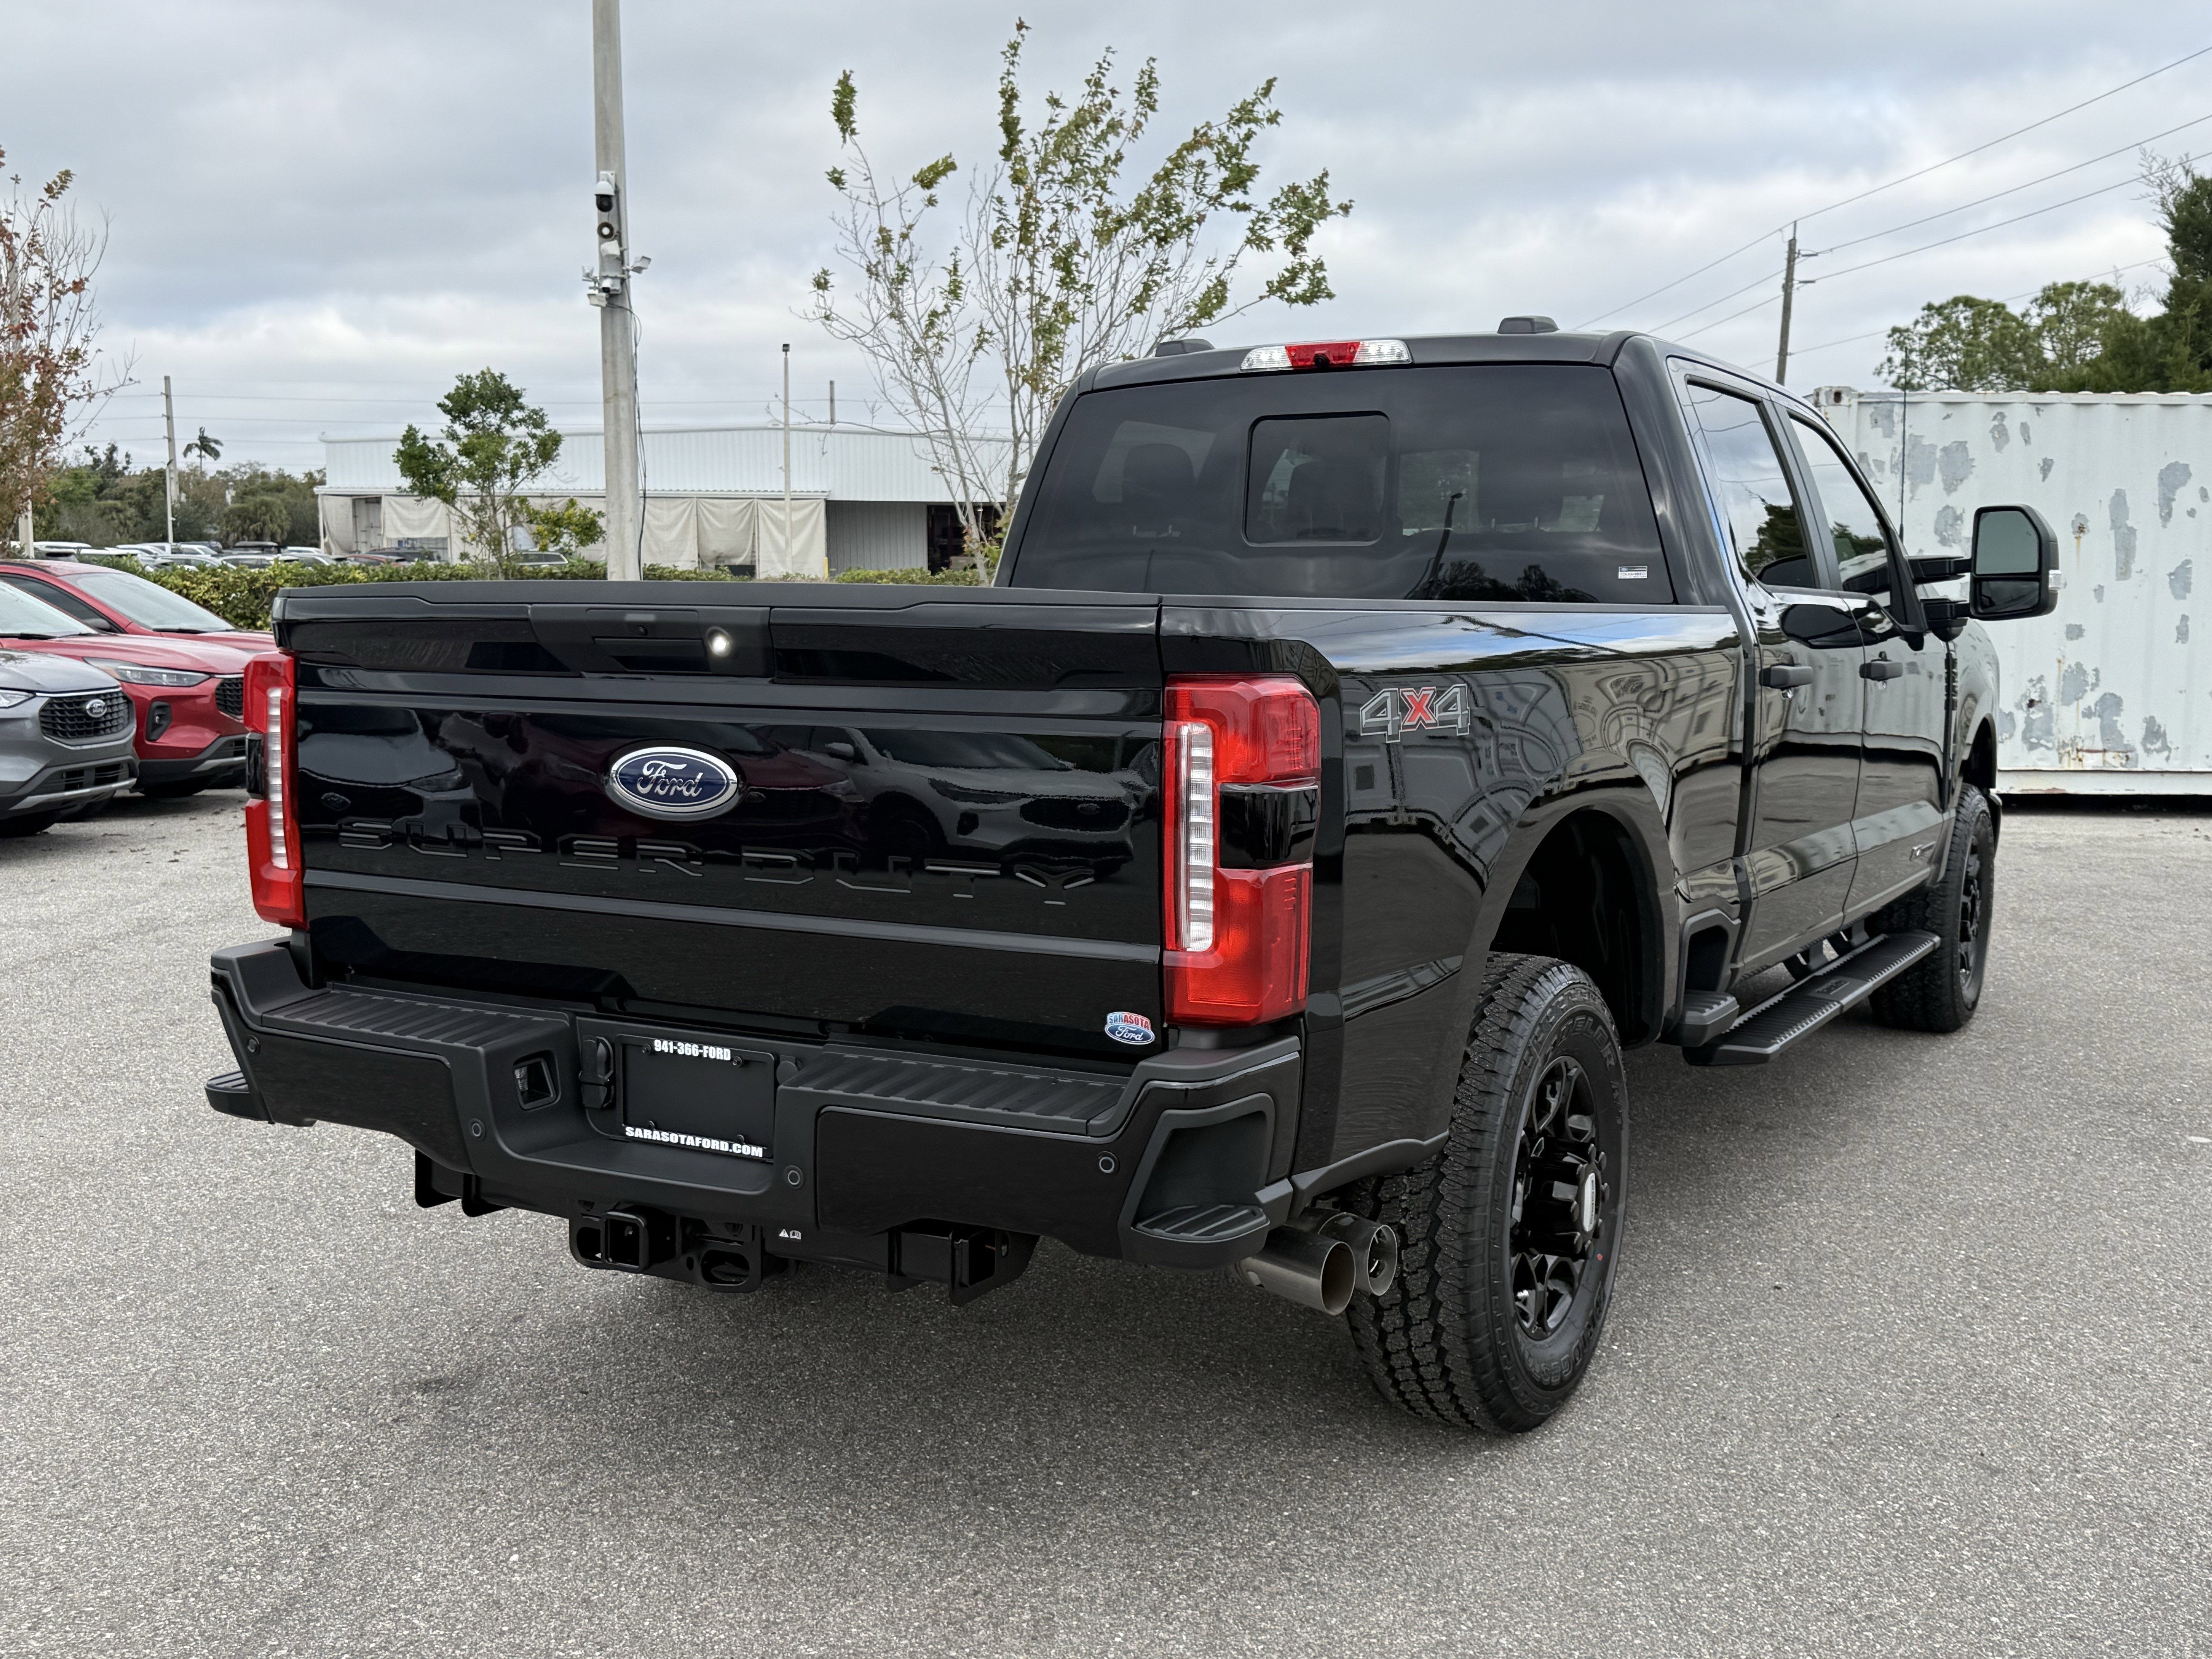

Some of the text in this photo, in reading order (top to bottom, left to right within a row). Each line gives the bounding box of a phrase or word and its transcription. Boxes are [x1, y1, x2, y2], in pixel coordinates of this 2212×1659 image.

[637, 760, 702, 797] Ford
[338, 818, 1095, 905] SUPER DUTY
[1109, 1013, 1149, 1030] SARASOTA
[1115, 1026, 1144, 1040] Ford
[654, 1039, 731, 1061] 941-366-FORD
[625, 1126, 763, 1158] SARASOTAFORD.COM
